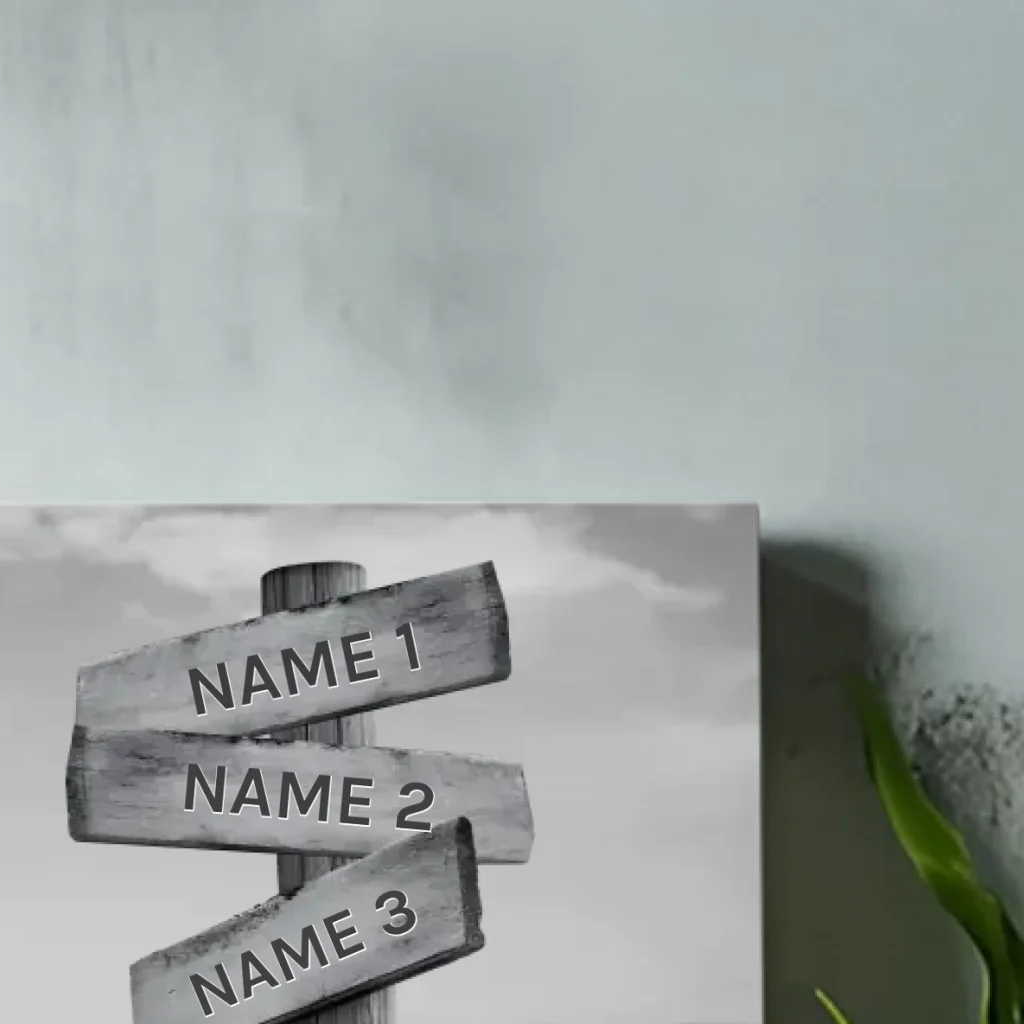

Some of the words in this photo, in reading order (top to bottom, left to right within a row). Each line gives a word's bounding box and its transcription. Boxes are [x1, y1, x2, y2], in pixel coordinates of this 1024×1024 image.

[188, 631, 381, 717] NAME
[395, 622, 421, 672] 1
[184, 763, 375, 827] NAME
[395, 782, 435, 832] 2
[189, 908, 367, 1018] NAME
[375, 890, 418, 937] 3
